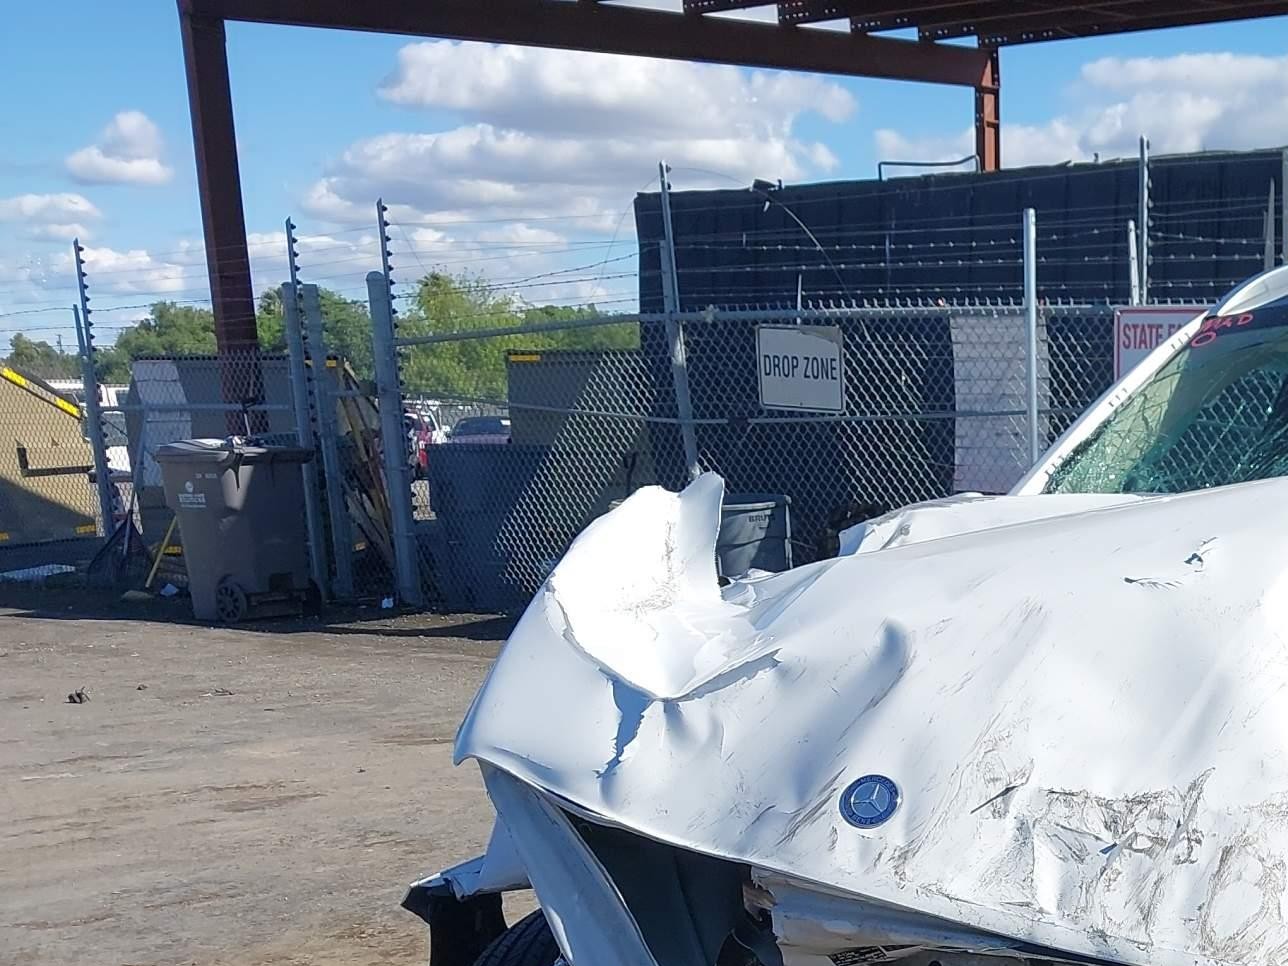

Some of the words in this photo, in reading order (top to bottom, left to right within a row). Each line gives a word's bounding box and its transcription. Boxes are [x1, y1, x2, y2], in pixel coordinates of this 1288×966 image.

[1122, 323, 1164, 350] STATE
[763, 354, 799, 378] DROP
[803, 357, 838, 380] ZONE
